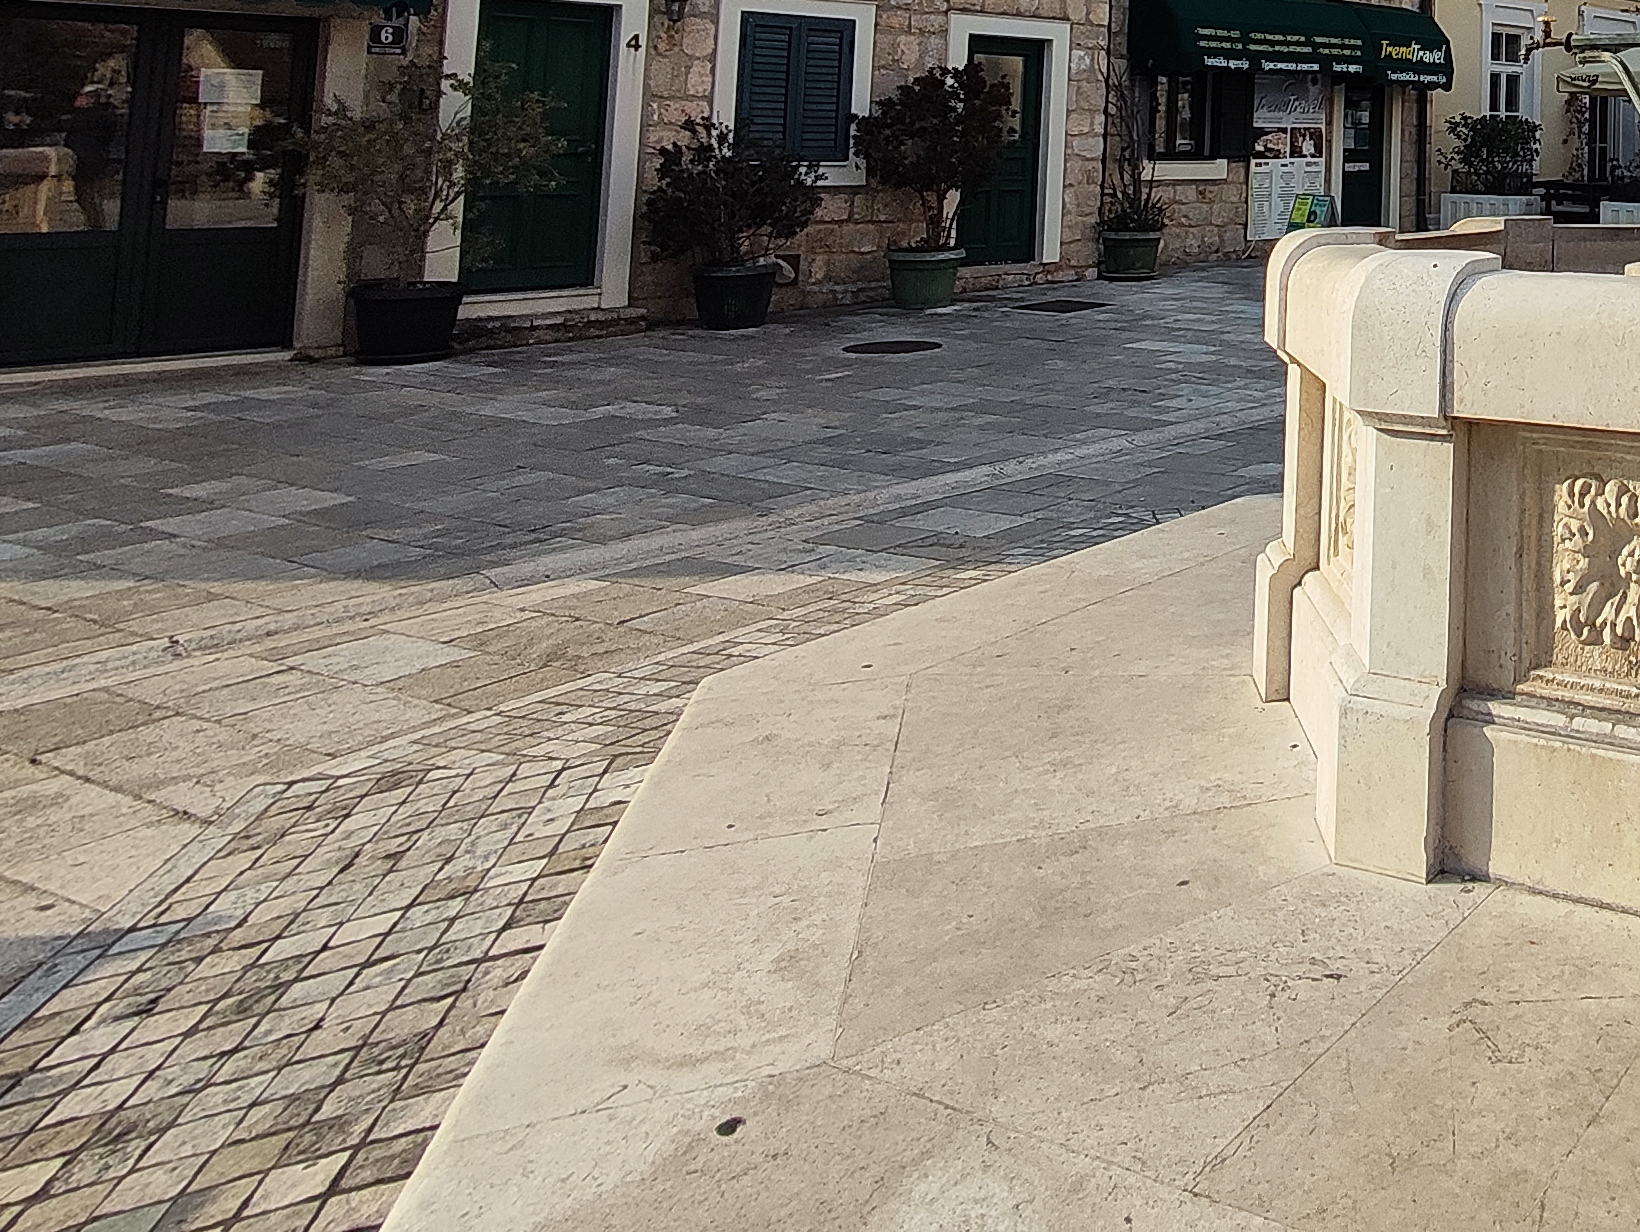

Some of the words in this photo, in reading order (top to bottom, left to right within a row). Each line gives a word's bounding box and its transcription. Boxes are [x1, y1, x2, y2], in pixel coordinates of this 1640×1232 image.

[380, 26, 394, 44] 6
[625, 33, 643, 53] 4
[1380, 39, 1447, 64] TrendTravel
